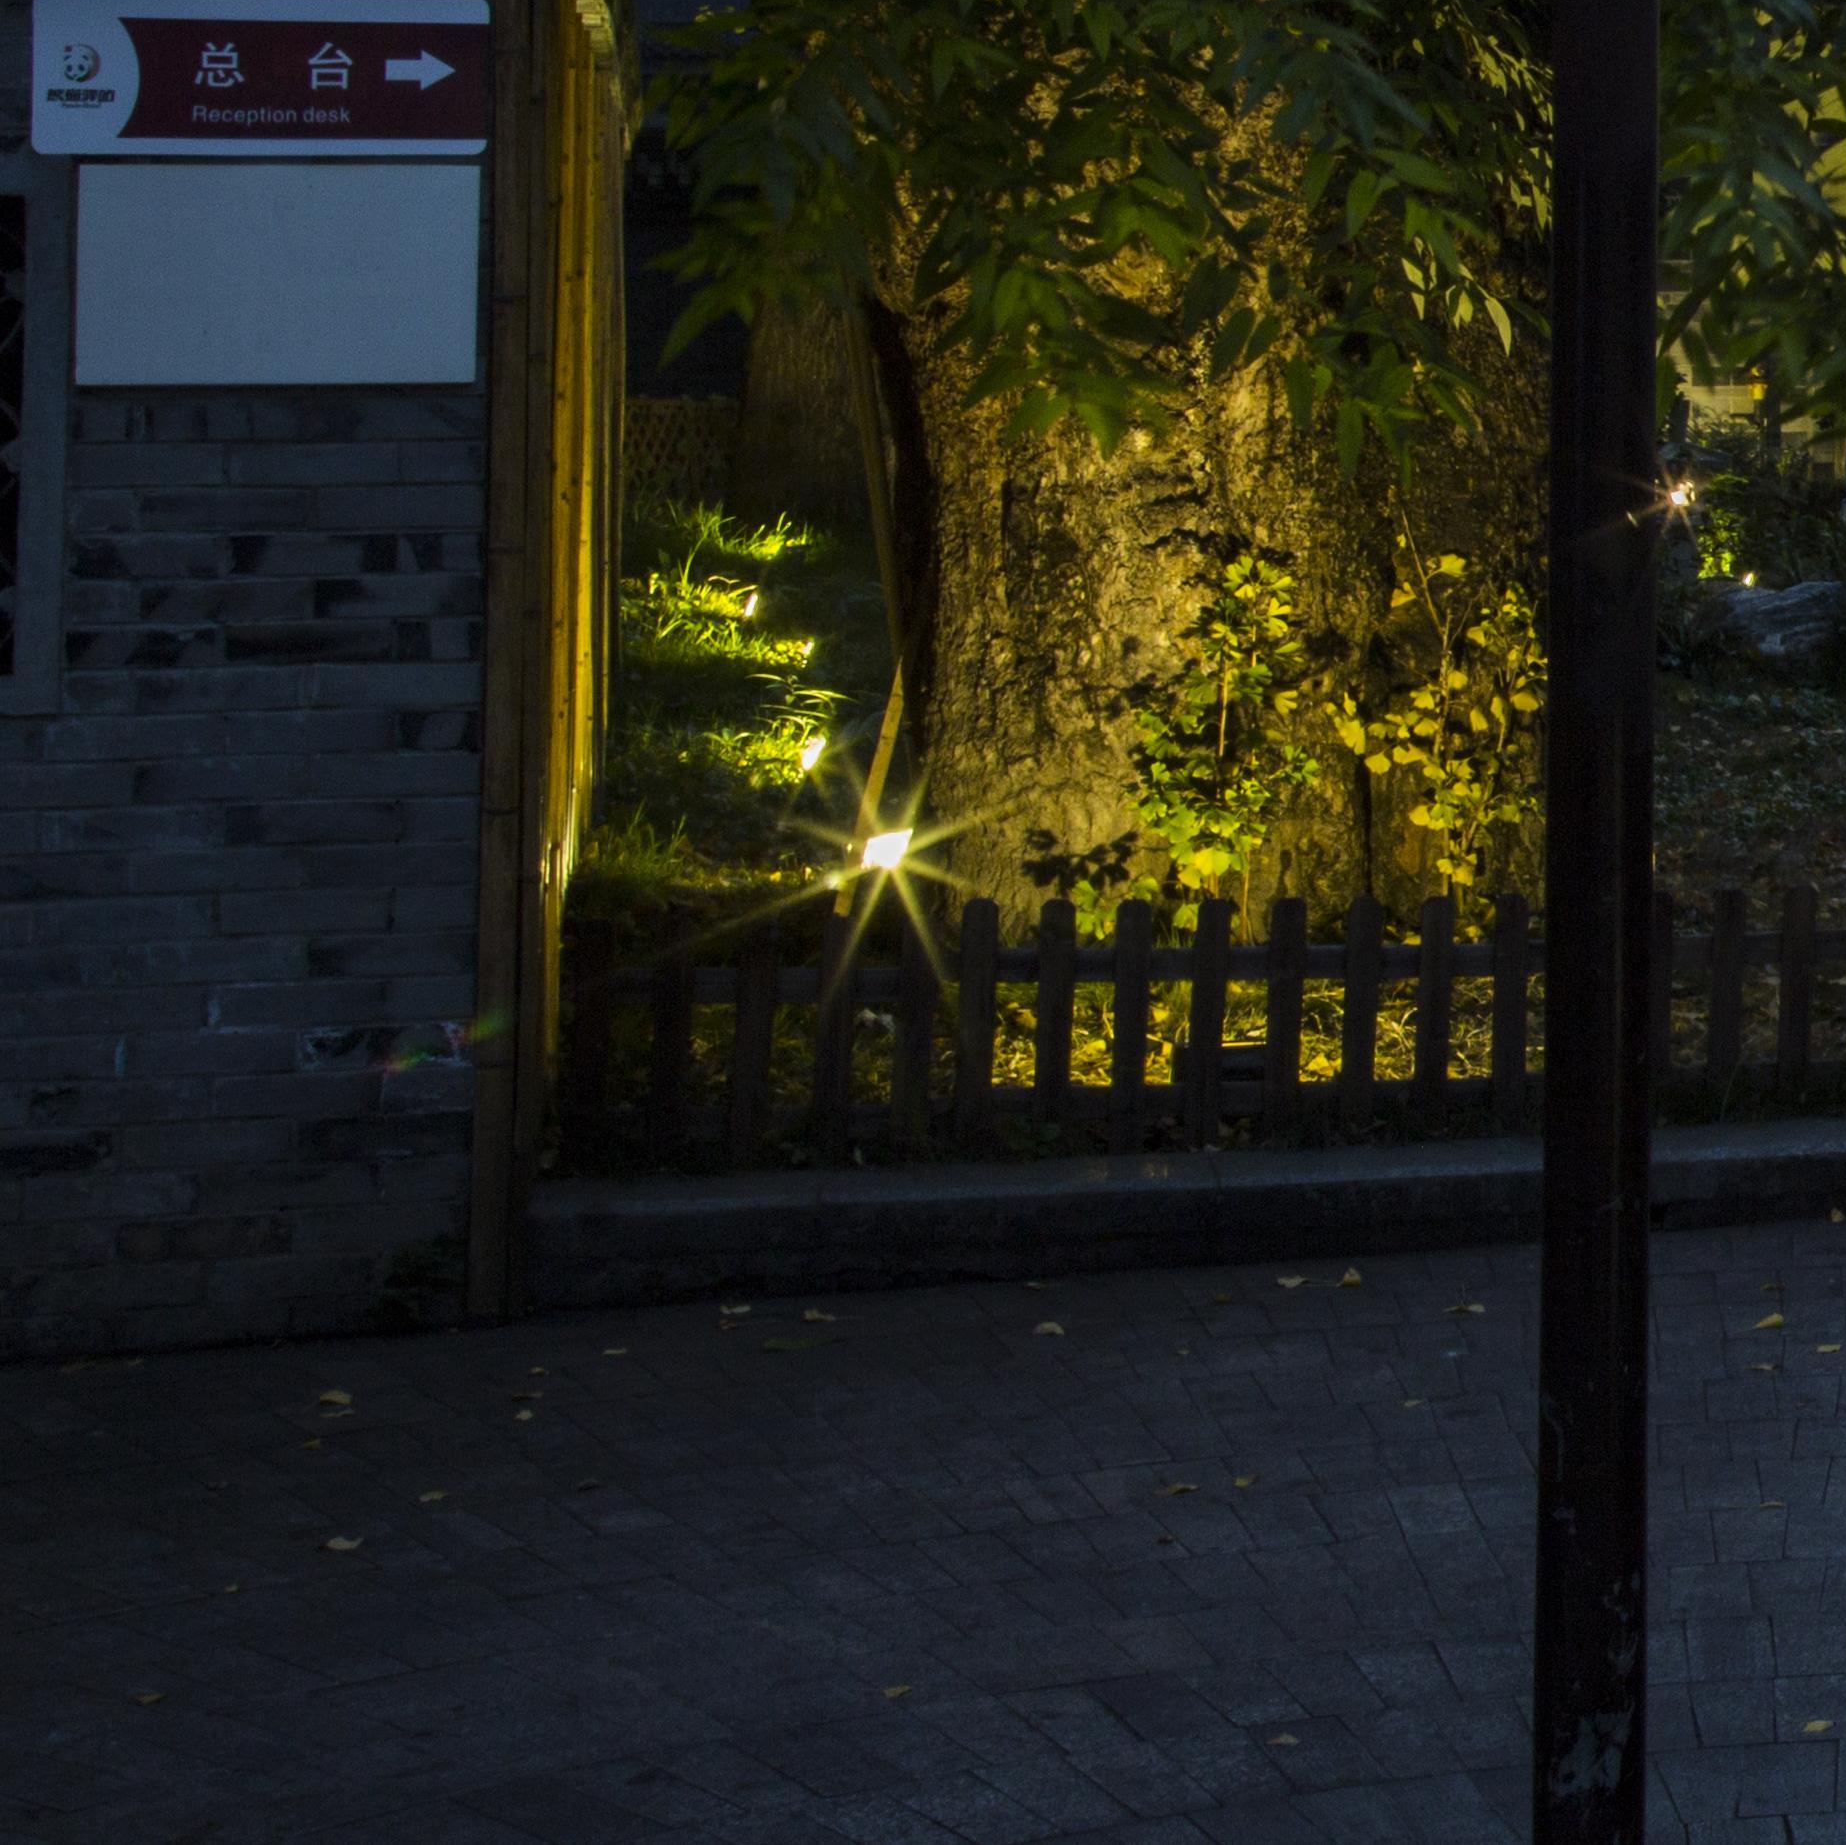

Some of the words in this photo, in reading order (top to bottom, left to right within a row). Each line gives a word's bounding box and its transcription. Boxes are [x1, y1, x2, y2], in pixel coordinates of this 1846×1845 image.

[194, 41, 354, 90] 总台
[192, 105, 298, 126] Reception
[302, 106, 351, 124] desk
